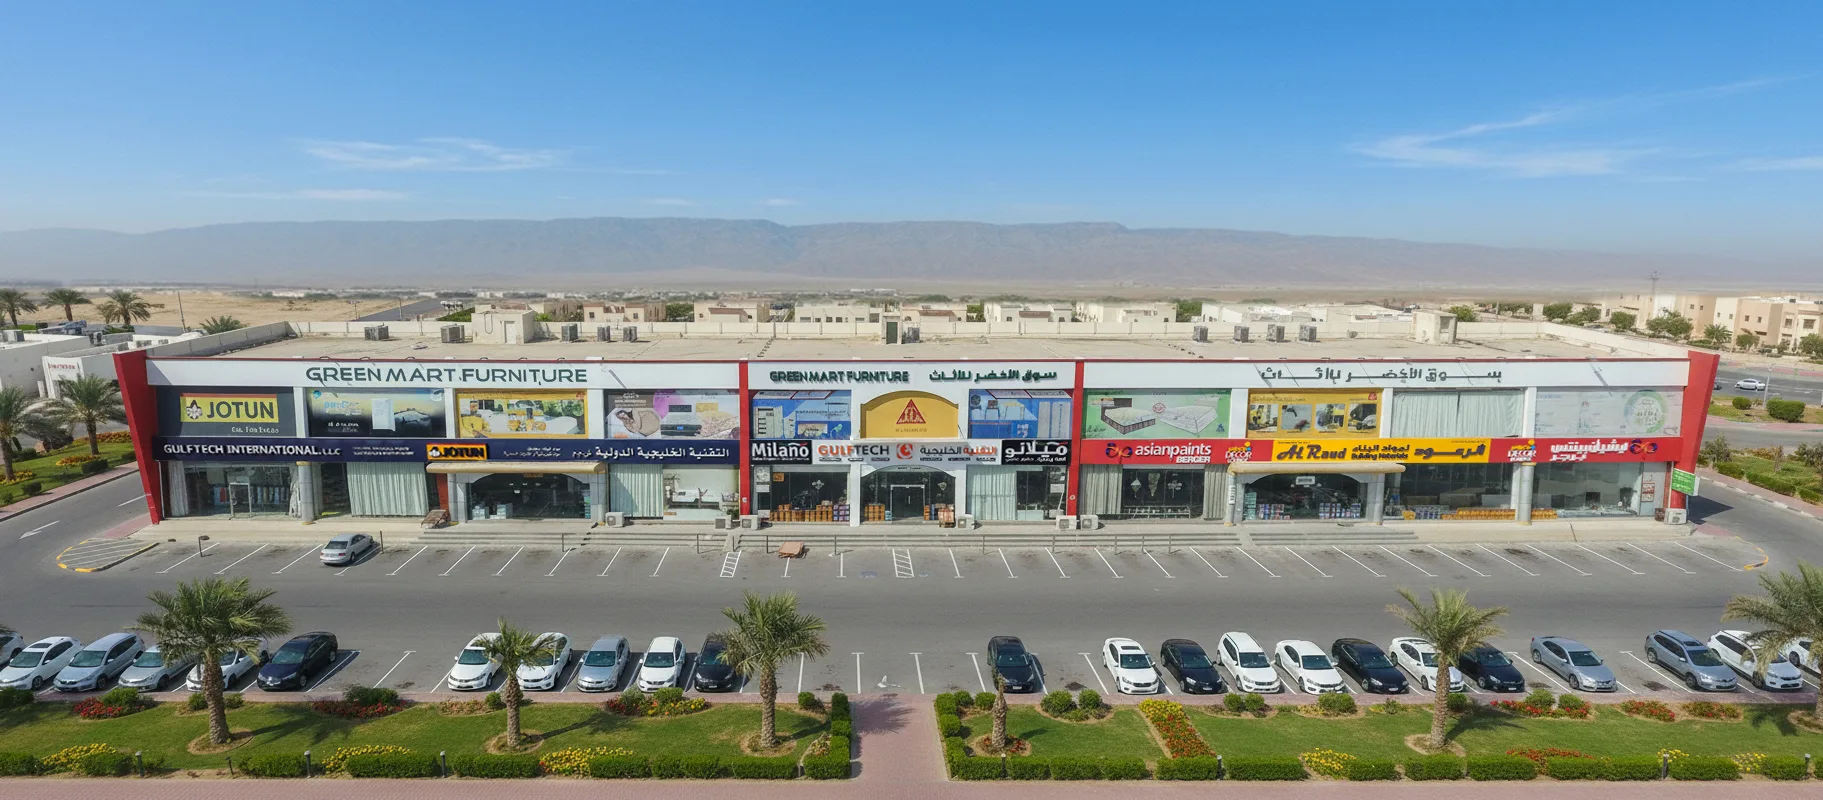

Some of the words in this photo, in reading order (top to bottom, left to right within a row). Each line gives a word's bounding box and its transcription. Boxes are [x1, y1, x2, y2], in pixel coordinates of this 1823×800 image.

[305, 367, 381, 382] GREEN
[386, 367, 455, 382] MART
[462, 368, 587, 383] FURNITURE
[769, 371, 807, 382] GREEN
[809, 371, 845, 382] MART
[847, 371, 909, 382] FURNITURE
[1022, 369, 1057, 382] سوق
[206, 401, 275, 419] JOTUN
[441, 446, 486, 458] JOTUN
[595, 446, 634, 460] الدولية
[637, 446, 686, 459] الخليجية
[689, 447, 730, 460] التقنية
[919, 445, 962, 457] الخليجية
[963, 445, 998, 456] التقنية
[1005, 441, 1069, 458] ميلانو
[1135, 442, 1212, 460] asianpaints
[1307, 444, 1347, 460] Raud
[1176, 456, 1211, 464] BERGER
